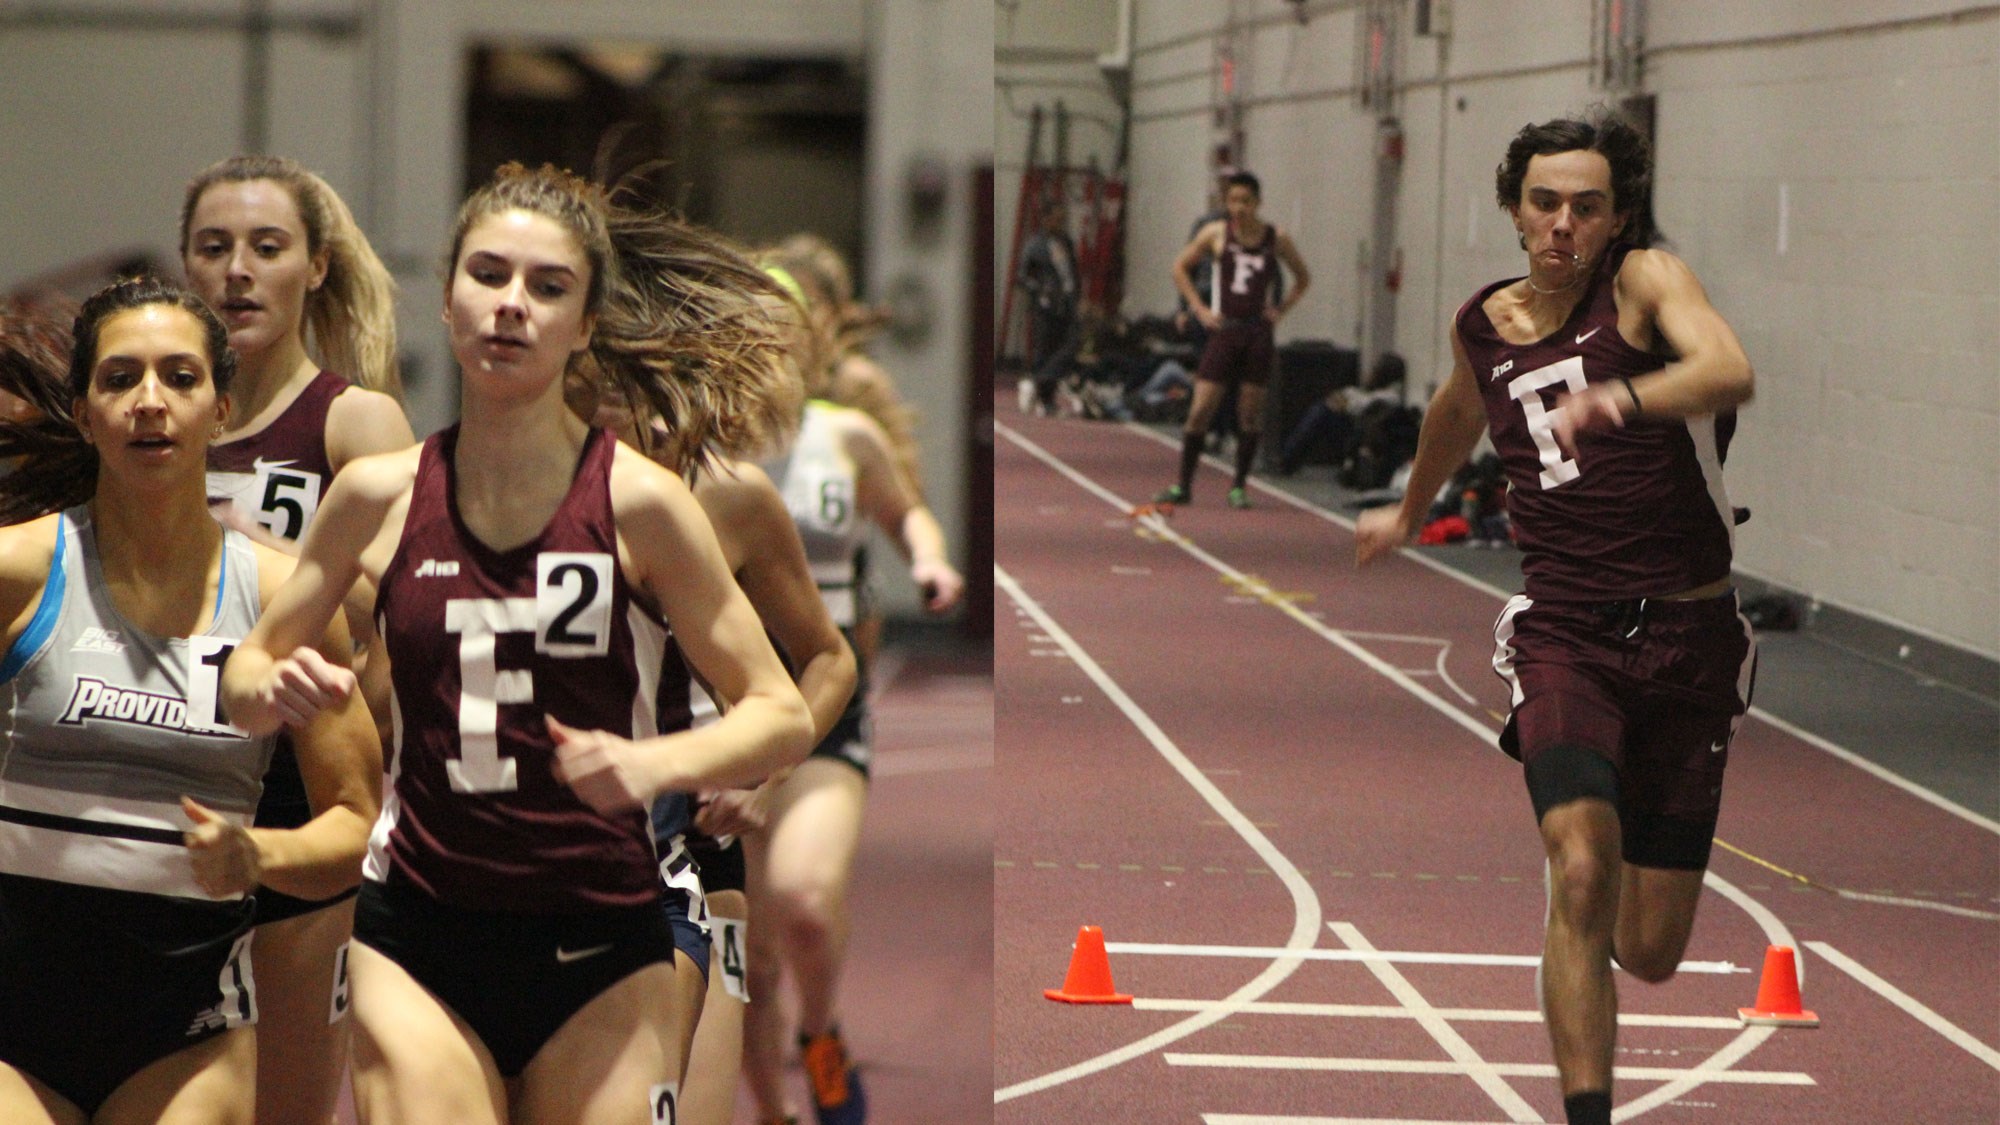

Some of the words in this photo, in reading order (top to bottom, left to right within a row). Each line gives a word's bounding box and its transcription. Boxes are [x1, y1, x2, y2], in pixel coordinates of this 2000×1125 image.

[1230, 252, 1265, 294] F
[1507, 355, 1589, 490] F
[257, 472, 307, 541] 5
[820, 479, 847, 526] 6
[84, 626, 120, 642] BIG
[543, 562, 600, 646] 2
[75, 639, 128, 653] EAST
[57, 674, 240, 738] PROVID
[201, 644, 235, 726] 1
[445, 597, 539, 793] F
[723, 924, 745, 993] 4
